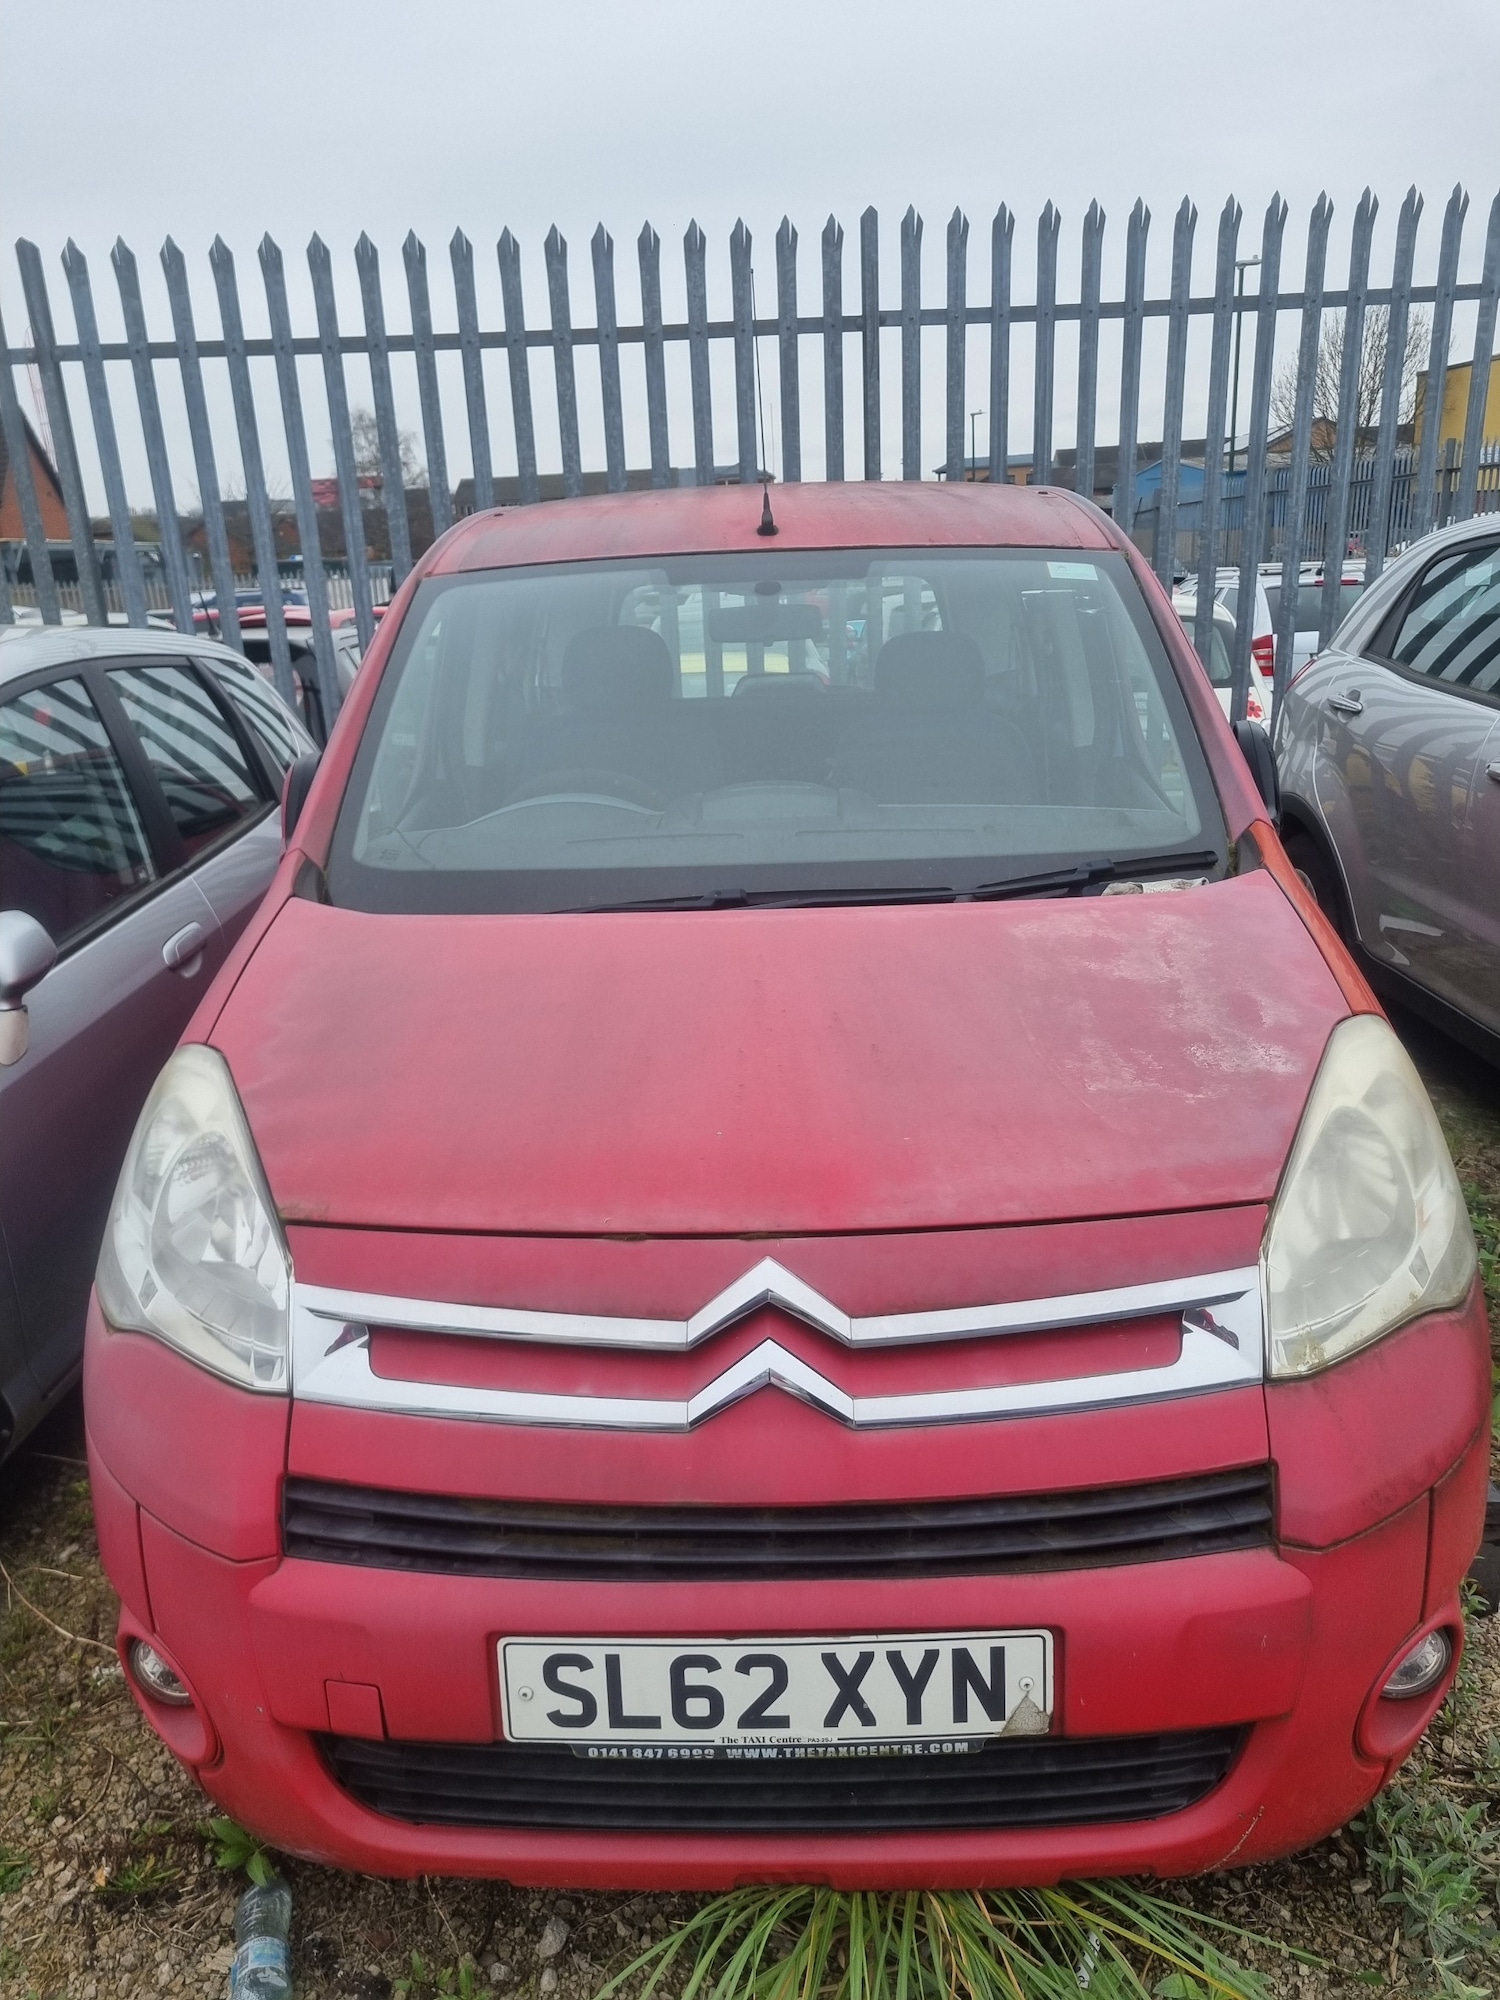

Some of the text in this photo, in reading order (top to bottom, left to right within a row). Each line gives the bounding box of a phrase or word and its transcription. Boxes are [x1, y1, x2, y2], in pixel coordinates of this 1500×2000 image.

[543, 1646, 1006, 1730] SL62 XYN
[719, 1736, 739, 1744] The
[741, 1736, 766, 1744] TAXI
[769, 1735, 803, 1744] Centre
[588, 1741, 969, 1759] 0141 847 6999 WWW.THETAXICENTRE.COM
